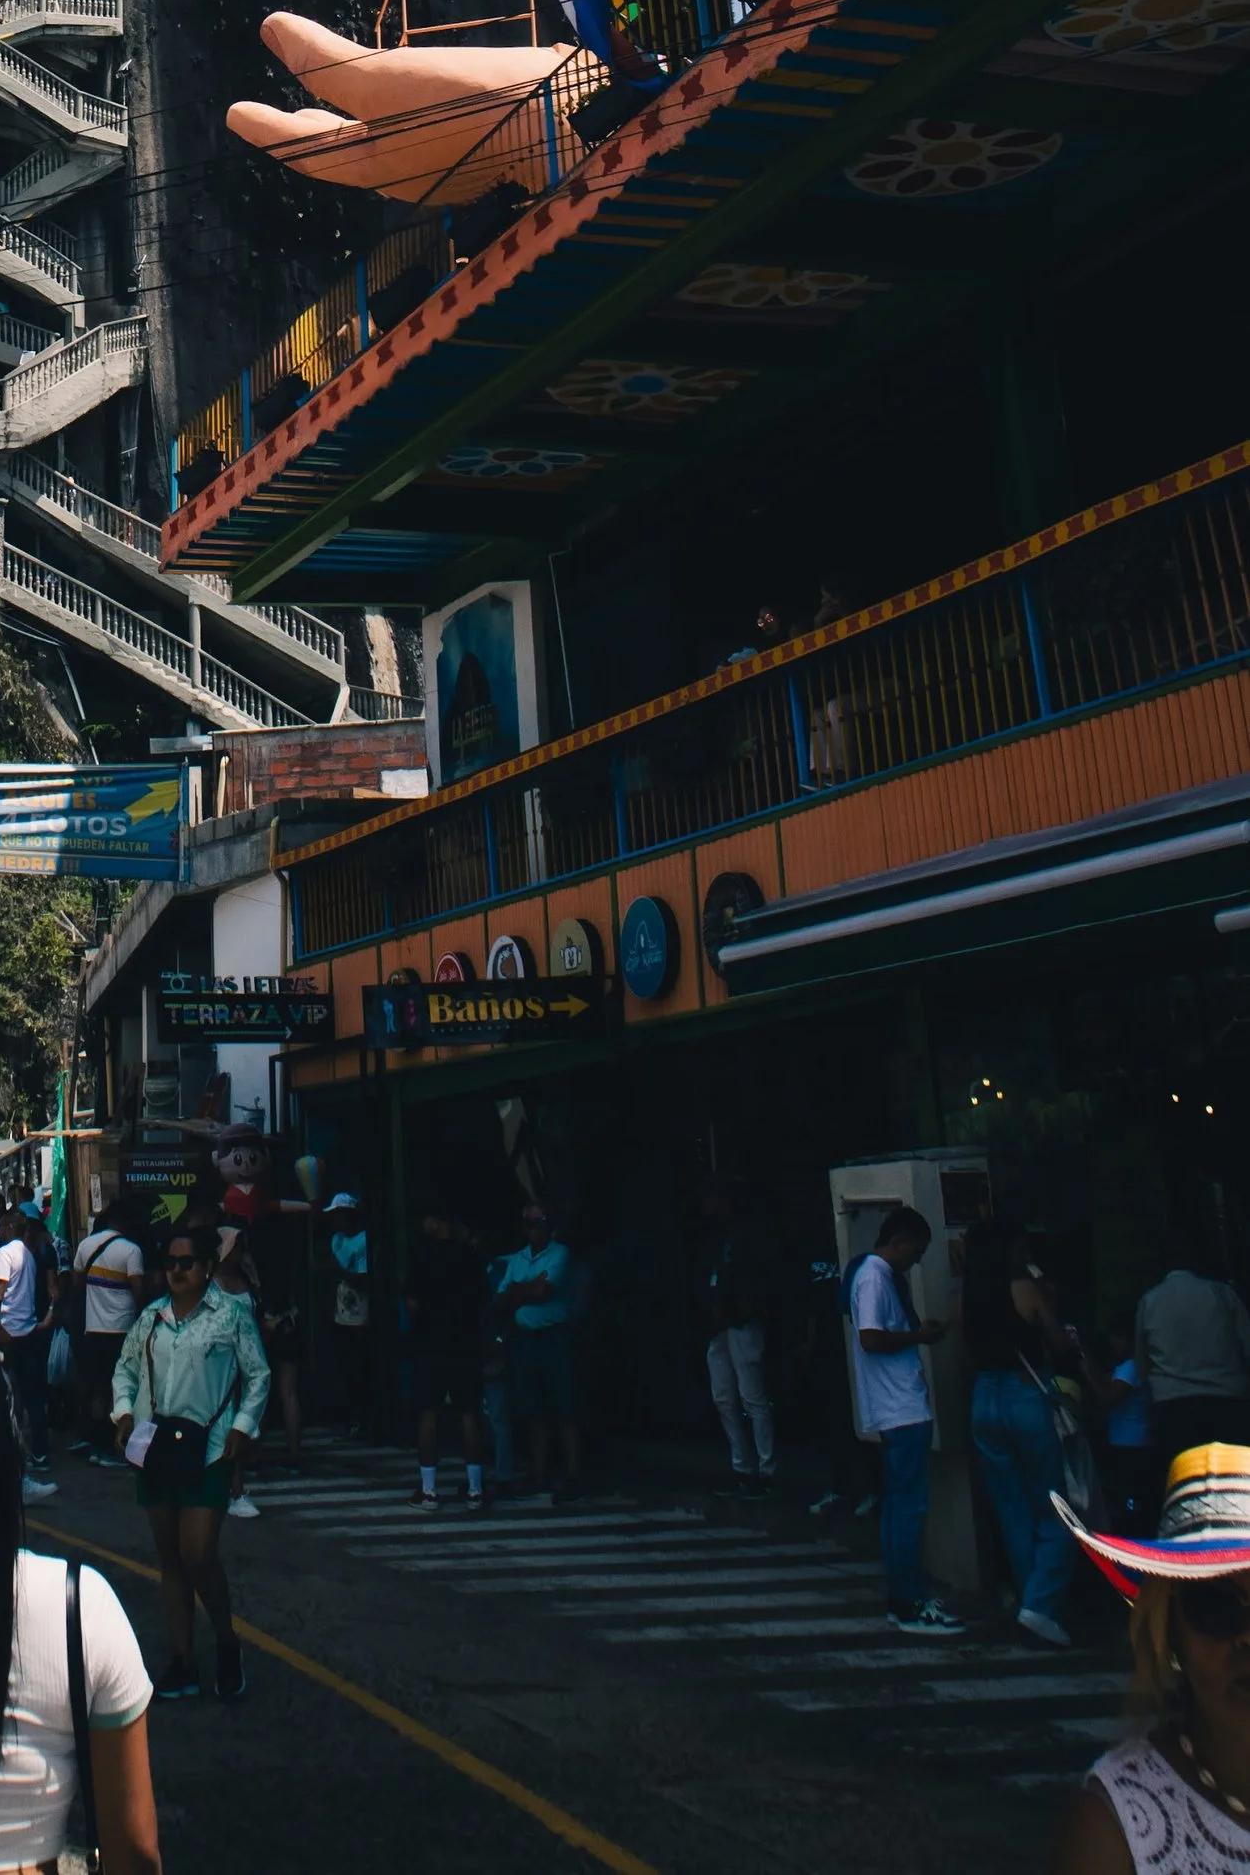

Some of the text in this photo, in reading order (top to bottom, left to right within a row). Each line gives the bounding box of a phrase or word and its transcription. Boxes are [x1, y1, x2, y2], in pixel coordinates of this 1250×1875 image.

[30, 814, 128, 836] FOTOS
[0, 834, 150, 852] QUE NO TE PUEDEN FALTAR
[200, 975, 239, 994] LAS
[163, 1002, 329, 1025] TERRAZA VIP
[427, 991, 545, 1024] Baños
[126, 1173, 170, 1183] TERRAZA
[170, 1173, 198, 1187] VIP
